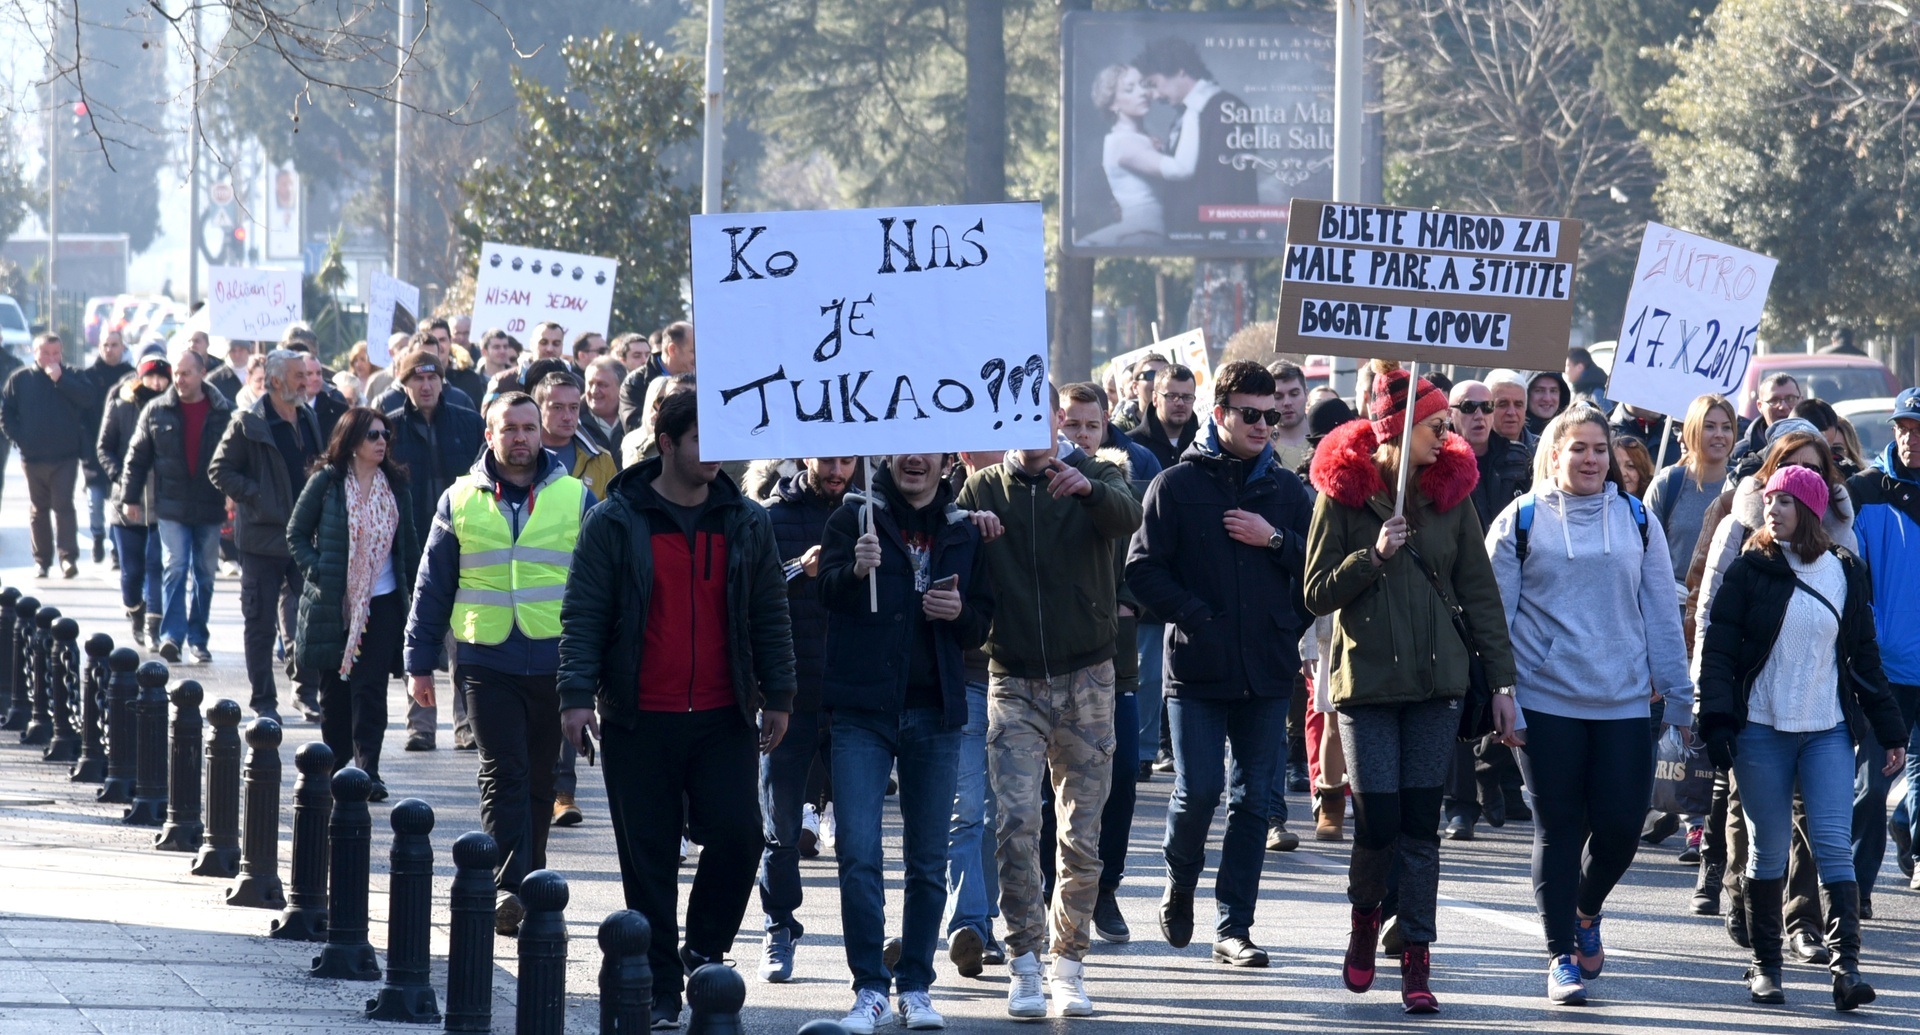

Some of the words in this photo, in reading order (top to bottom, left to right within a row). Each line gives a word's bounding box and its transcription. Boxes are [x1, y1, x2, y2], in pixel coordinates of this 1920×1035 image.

[1220, 100, 1287, 124] Santa
[1294, 101, 1336, 124] Ma
[1226, 126, 1281, 149] della
[1288, 126, 1336, 150] Salu
[877, 217, 989, 274] NAS
[1321, 205, 1408, 245] BIJETE
[1418, 212, 1505, 251] NAROD
[1513, 221, 1550, 253] ZA
[1285, 246, 1356, 283] MALE
[1469, 258, 1568, 299] ŠTITITE
[485, 286, 531, 307] NISAM
[545, 291, 588, 312] JEDAN
[507, 318, 526, 333] OD
[812, 292, 876, 363] JE
[1301, 300, 1393, 341] BOGATE
[1408, 307, 1507, 347] LOPOVE
[1695, 769, 1714, 779] IRIS
